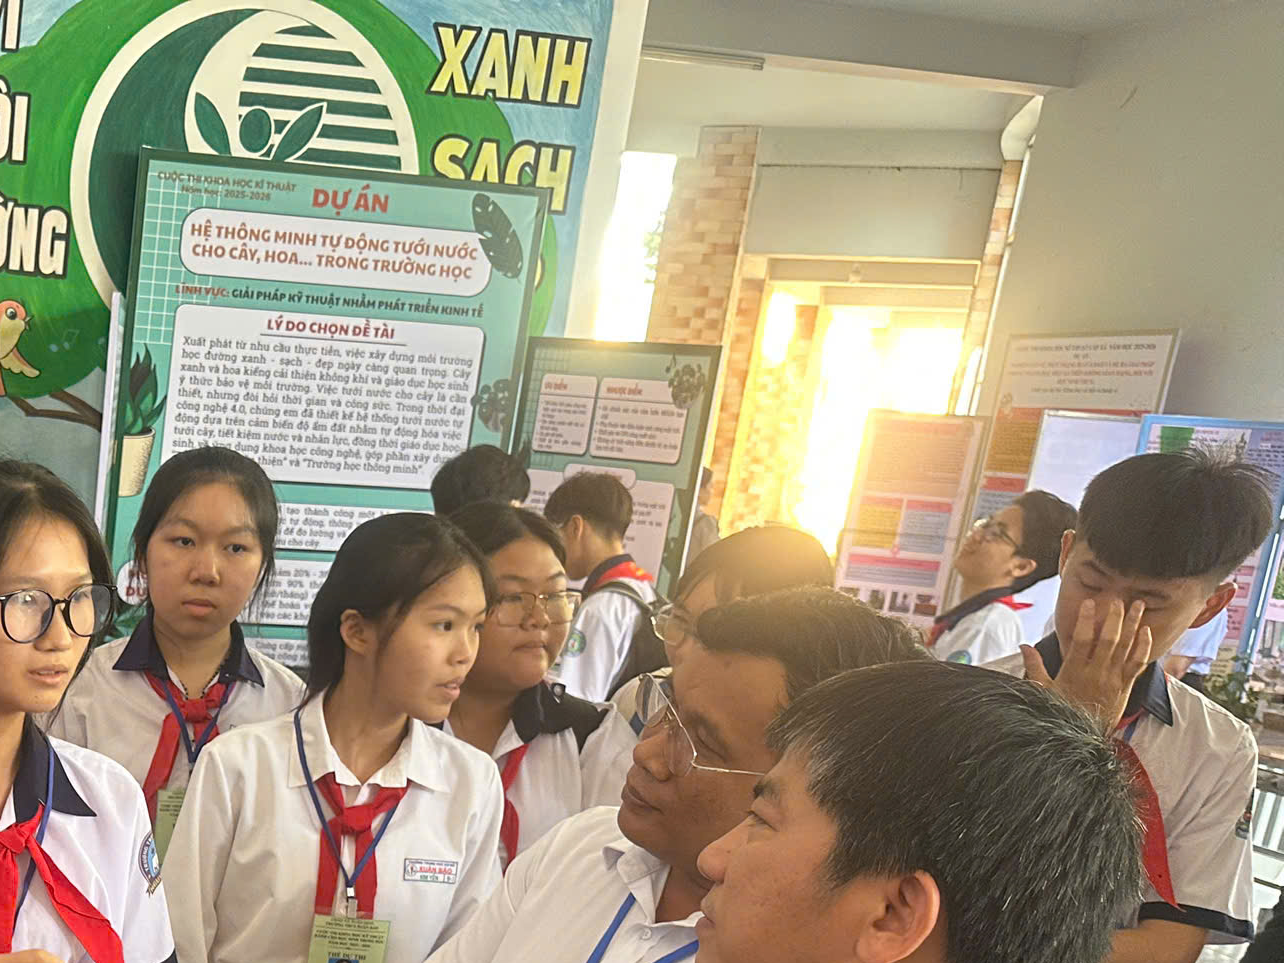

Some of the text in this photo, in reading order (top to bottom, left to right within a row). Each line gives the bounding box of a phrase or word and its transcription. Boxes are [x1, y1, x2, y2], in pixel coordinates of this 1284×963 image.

[426, 22, 592, 109] XANH
[187, 174, 202, 183] THI
[203, 176, 230, 187] KHOA
[232, 179, 253, 190] HỌC
[224, 189, 271, 201] 2025-2026
[312, 184, 390, 216] DỰ ÁN
[191, 219, 478, 261] HỆ THÔNG MINH TỰ ĐỘNG TƯỚI NƯỚC
[192, 243, 472, 283] CHO CÂY, HOA... TRONG TRƯỜNG HỌC
[231, 286, 255, 300] GIẢI
[256, 288, 286, 302] PHÁP
[305, 293, 340, 309] THUẬT
[342, 293, 375, 309] NHẰM
[377, 297, 406, 311] PHÁT
[408, 298, 440, 315] TRIỂN
[441, 305, 470, 317] KINH
[471, 303, 484, 318] TẾ
[267, 315, 395, 339] LÝ DO CHỌN ĐỀ TÀI
[249, 340, 270, 351] nhu
[180, 361, 206, 372] xanh
[222, 364, 241, 375] hoa
[447, 380, 468, 391] sinh
[240, 353, 267, 363] xanh
[391, 364, 417, 376] quan
[282, 406, 299, 417] em
[304, 396, 327, 408] gian
